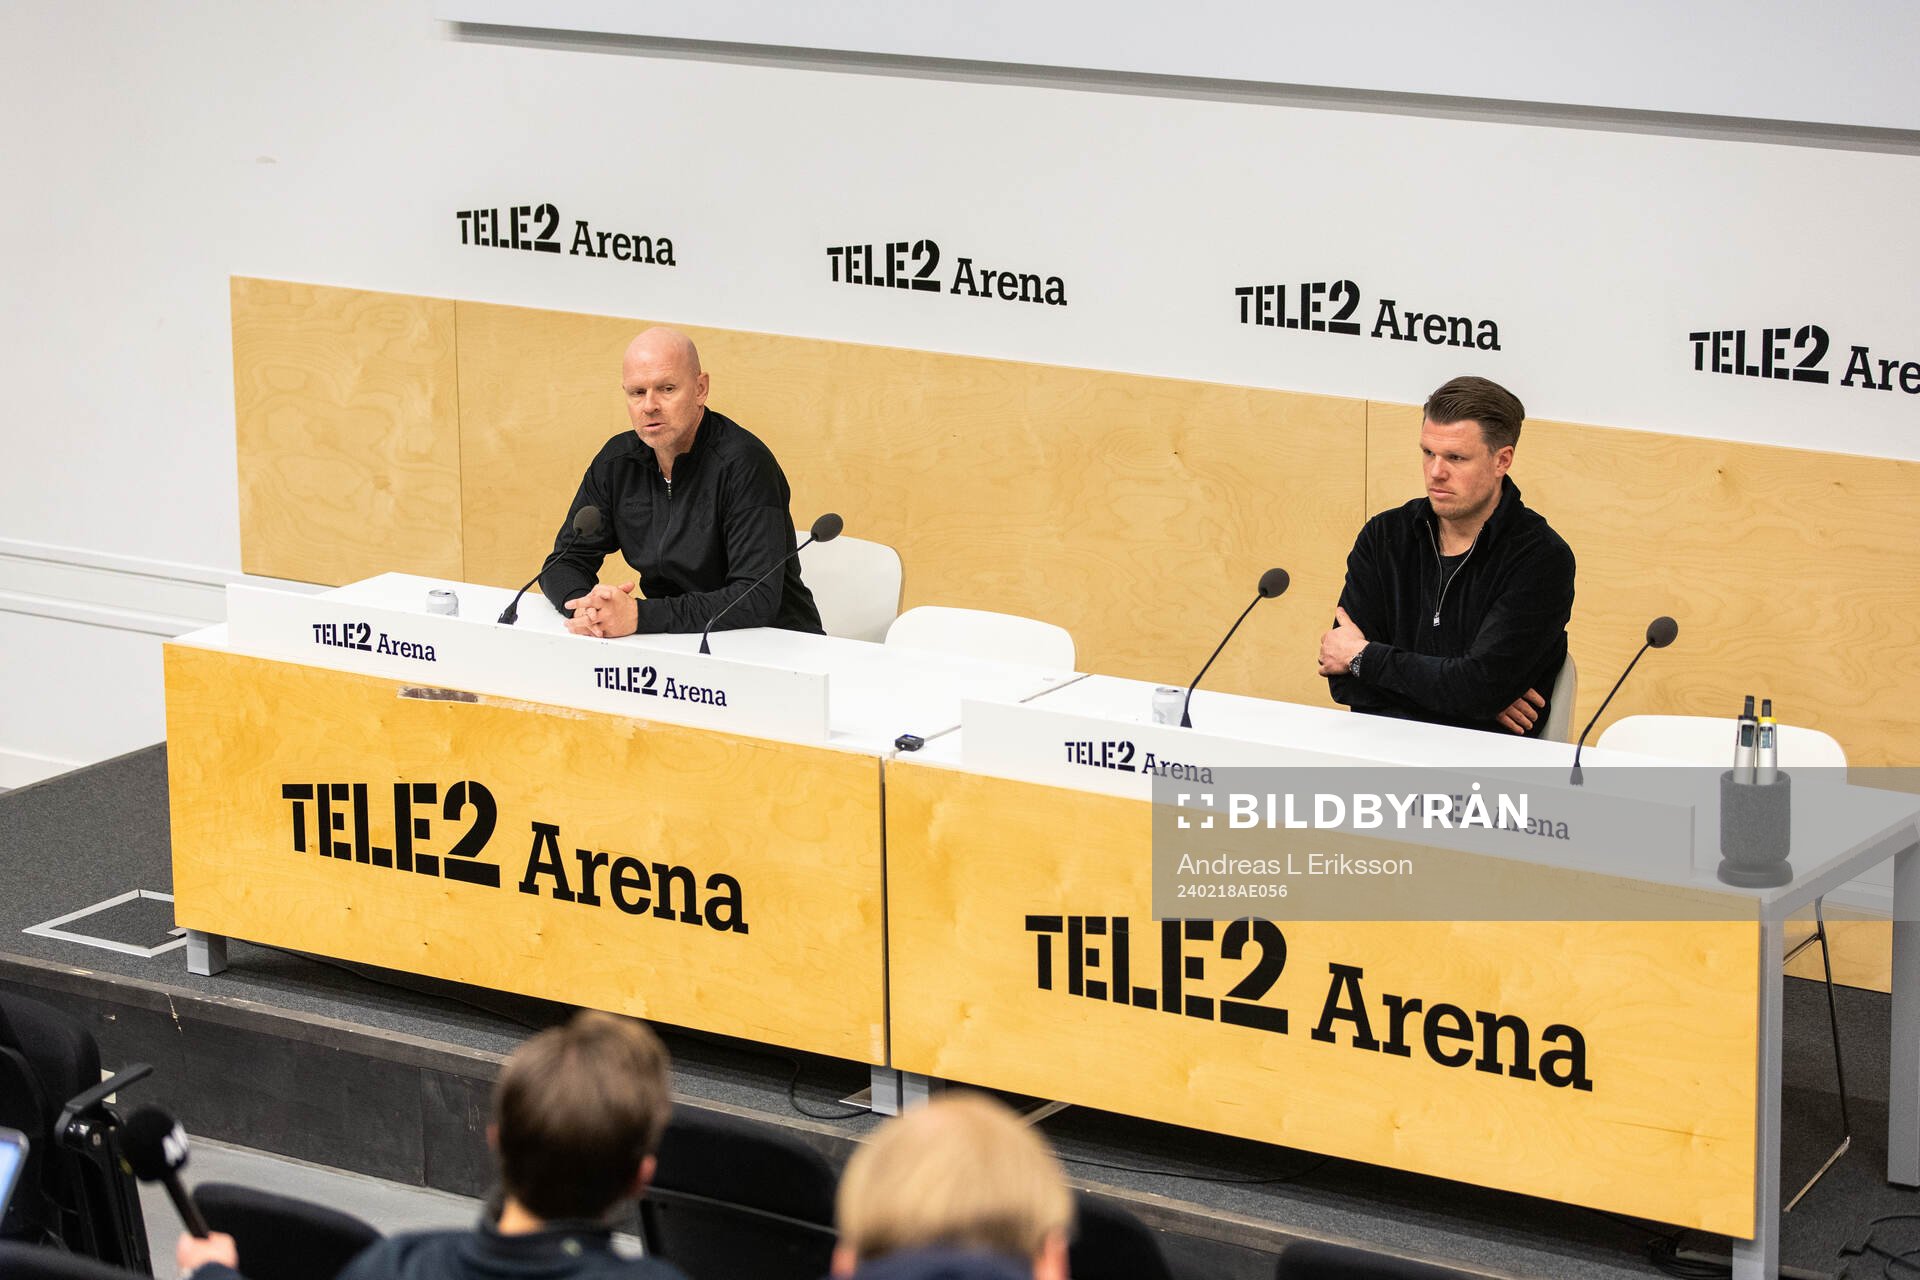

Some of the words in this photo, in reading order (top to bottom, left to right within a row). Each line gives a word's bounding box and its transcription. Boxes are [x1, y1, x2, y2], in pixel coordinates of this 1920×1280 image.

[456, 203, 561, 254] TELE2
[569, 220, 676, 267] Arena
[826, 239, 941, 293] TELE2
[950, 257, 1068, 306] Arena
[1235, 279, 1361, 336] TELE2
[1370, 299, 1501, 351] Arena
[1689, 324, 1830, 385] TELE2
[312, 622, 371, 652] TELE2
[376, 633, 437, 662] Arena
[594, 666, 658, 697] TELE2
[662, 677, 727, 707] Arena
[1064, 741, 1136, 773] TELE2
[1141, 752, 1214, 785] Arena
[281, 780, 501, 889] TELE2
[518, 821, 749, 935] Arena
[1024, 915, 1289, 1035] TELE2
[1310, 962, 1593, 1093] Arena
